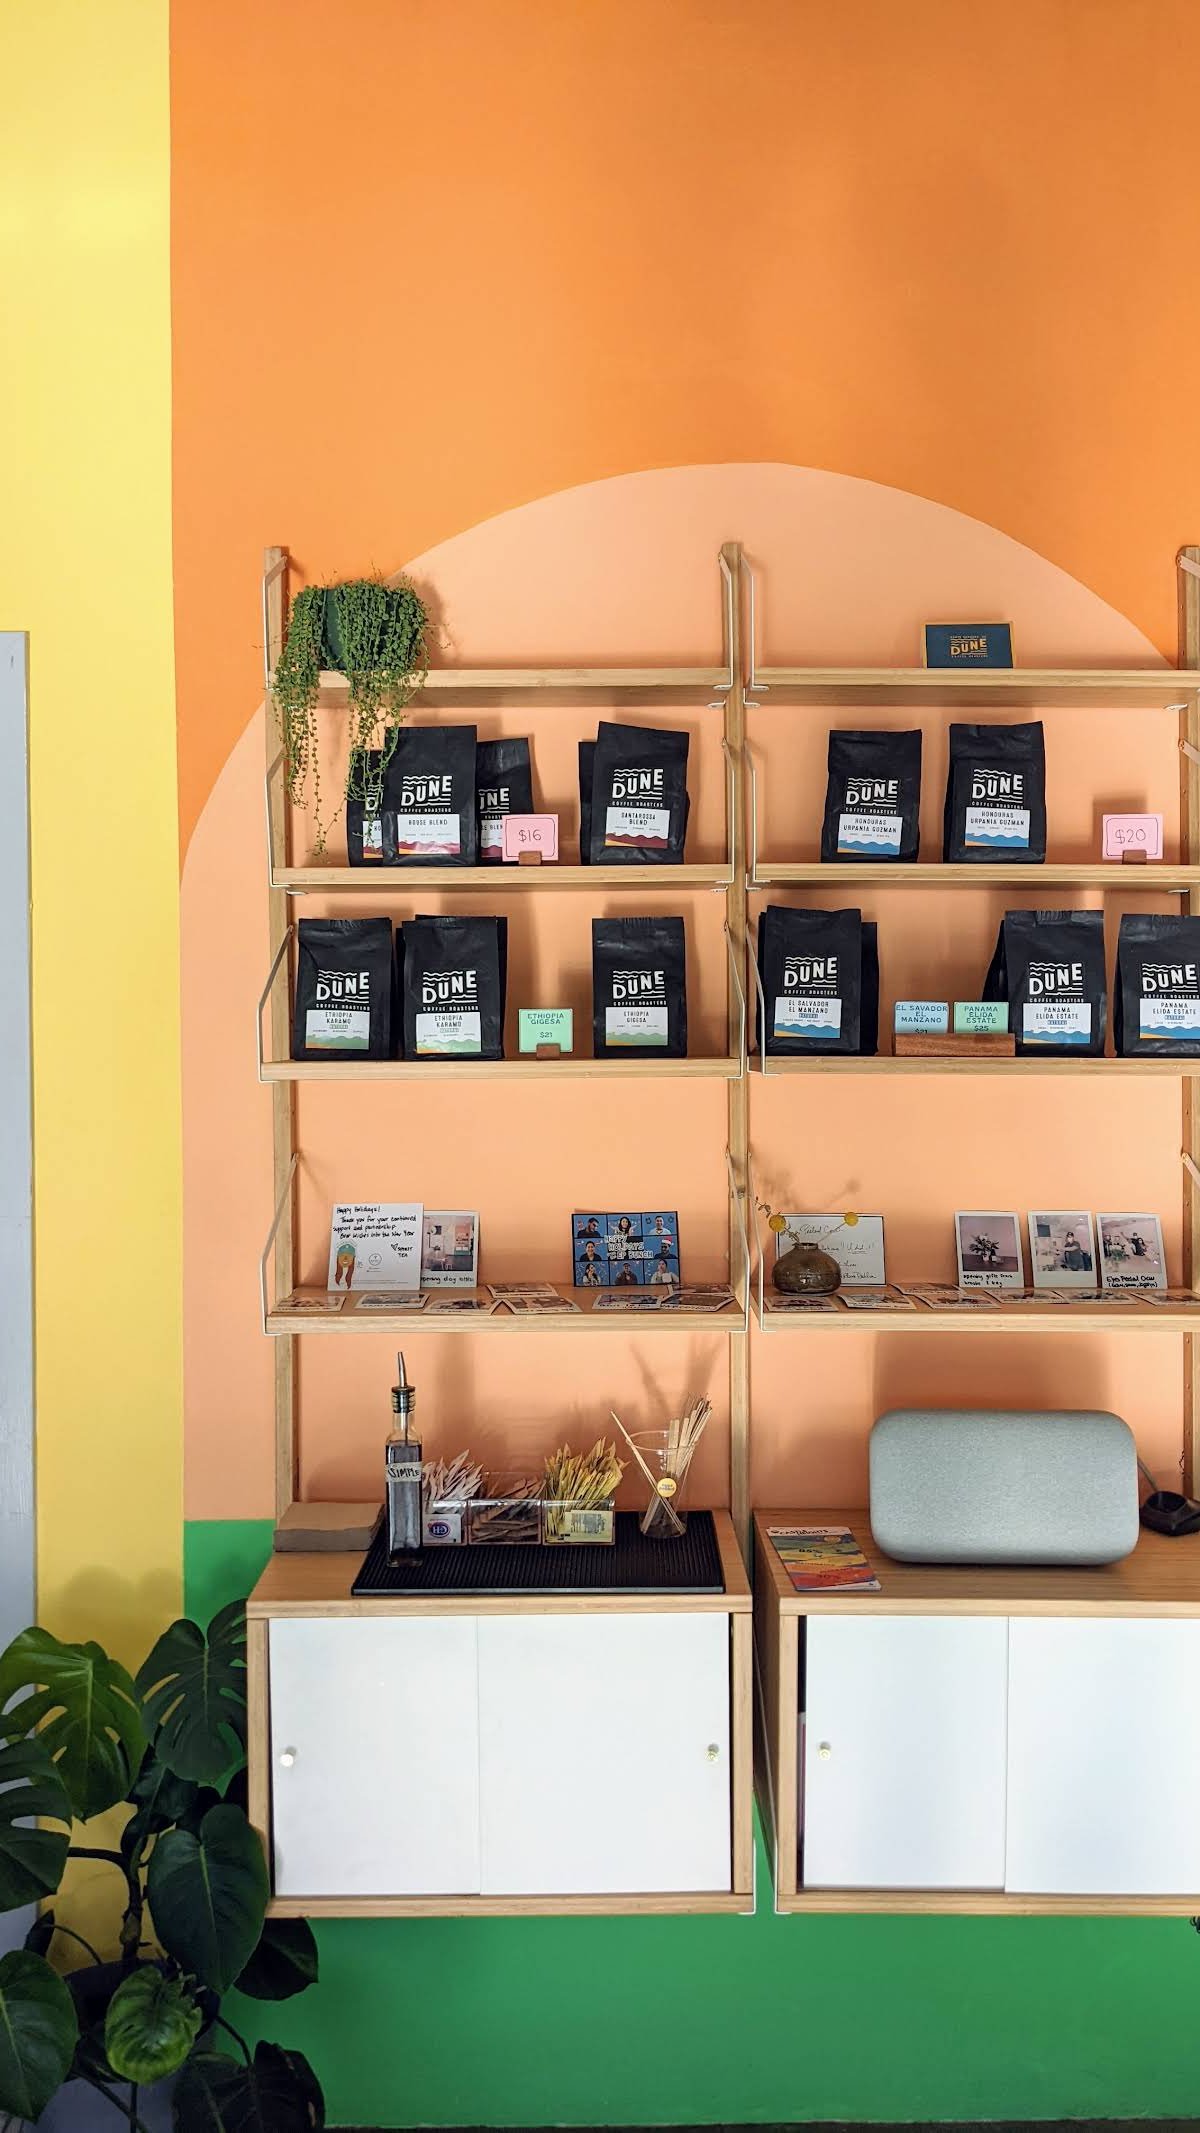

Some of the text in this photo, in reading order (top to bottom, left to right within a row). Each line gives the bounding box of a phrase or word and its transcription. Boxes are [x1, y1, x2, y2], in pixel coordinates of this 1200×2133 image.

[951, 638, 988, 655] DUNE
[401, 776, 452, 806] DUNE
[612, 769, 663, 799] DUNE
[846, 780, 898, 804] DUNE
[972, 774, 1023, 799] DUNE
[854, 818, 887, 826] HONDURAS
[518, 829, 542, 843] $16
[1115, 828, 1147, 844] $20
[612, 970, 665, 999] DUNE
[784, 957, 837, 987] DUNE
[1029, 963, 1083, 995] DUNE
[1142, 964, 1197, 992] DUNE
[316, 971, 370, 1001] DUNE
[422, 970, 477, 1004] DUNE
[443, 1276, 456, 1284] day
[388, 1467, 420, 1478] SIMPLE
